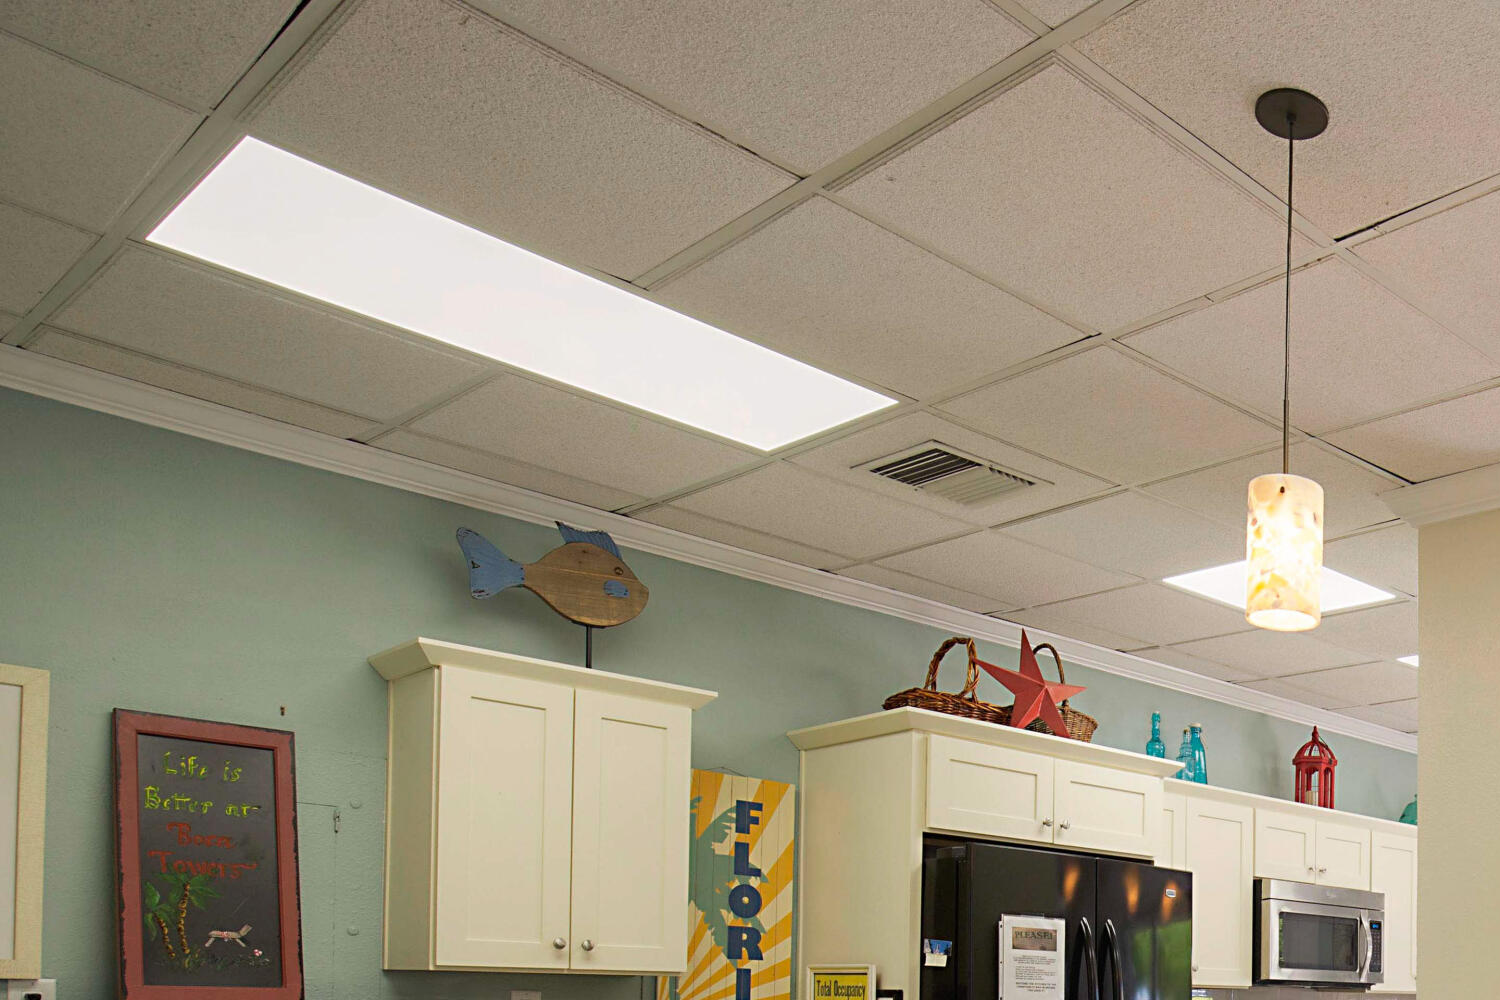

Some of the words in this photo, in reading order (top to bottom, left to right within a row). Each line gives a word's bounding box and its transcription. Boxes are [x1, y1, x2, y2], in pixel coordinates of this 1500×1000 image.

[163, 751, 208, 779] Life
[223, 760, 243, 782] is
[144, 785, 213, 814] Better
[225, 803, 261, 818] at
[147, 850, 258, 879] Towers
[816, 980, 832, 997] Total
